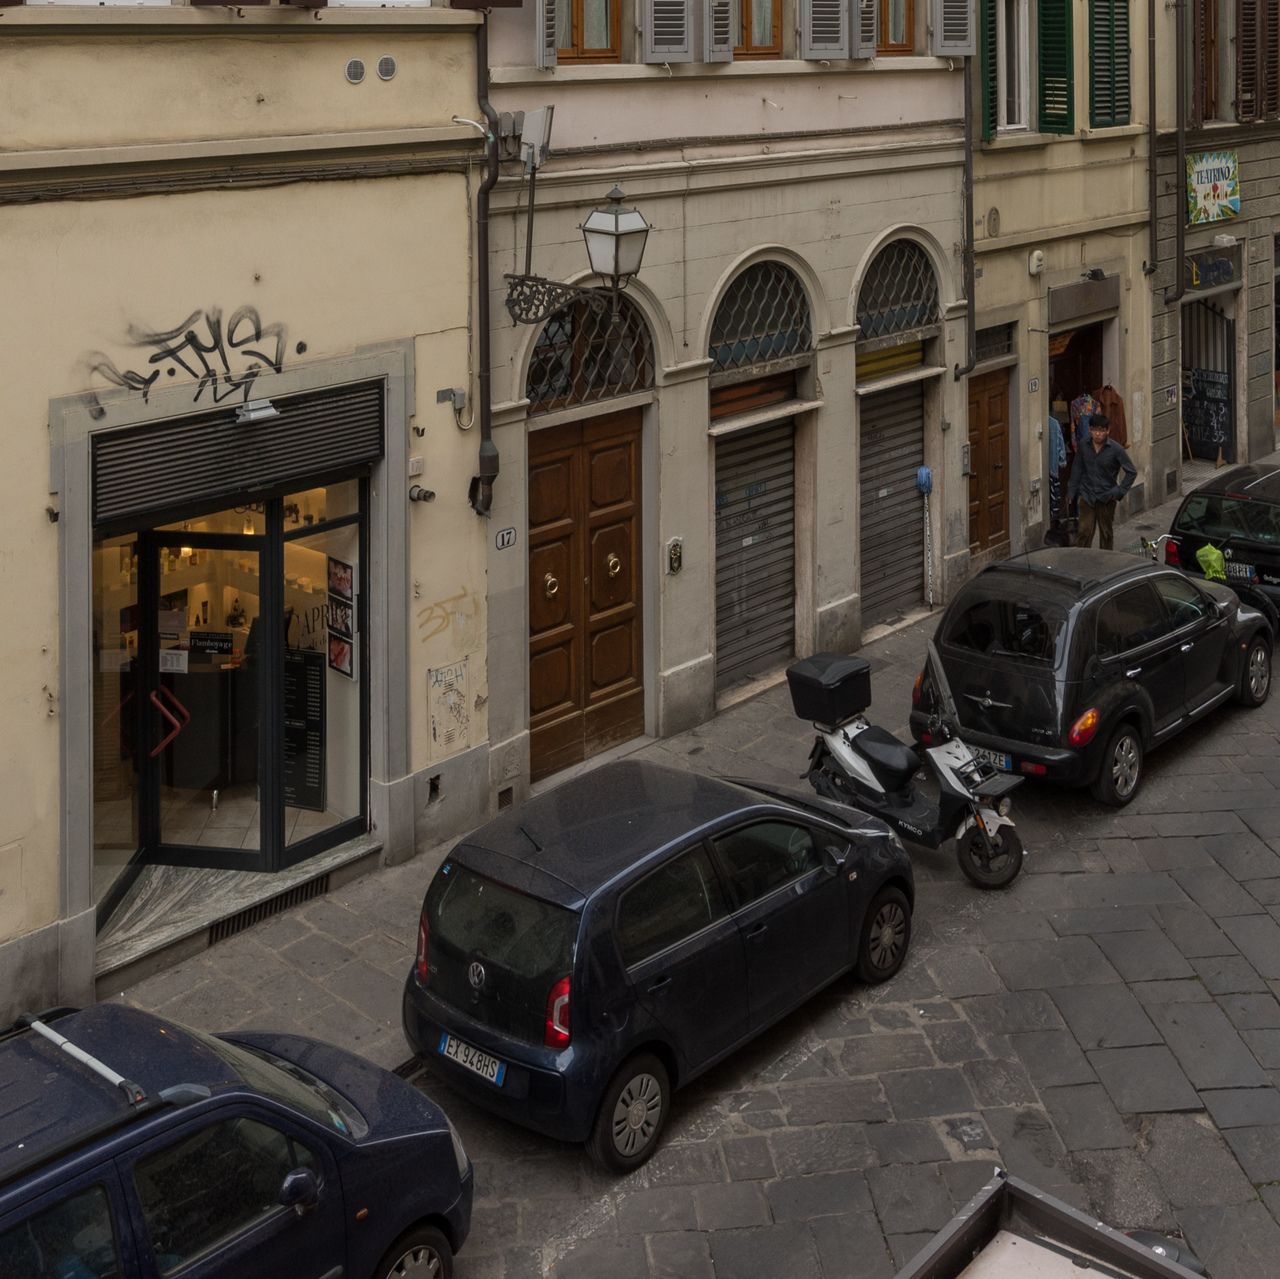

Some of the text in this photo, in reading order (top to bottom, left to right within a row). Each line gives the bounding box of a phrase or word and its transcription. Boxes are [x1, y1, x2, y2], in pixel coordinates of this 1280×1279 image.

[1195, 166, 1230, 185] TEATRINO
[500, 531, 512, 547] 17
[898, 820, 923, 836] KYMCO
[447, 1038, 497, 1079] EX 948HS
